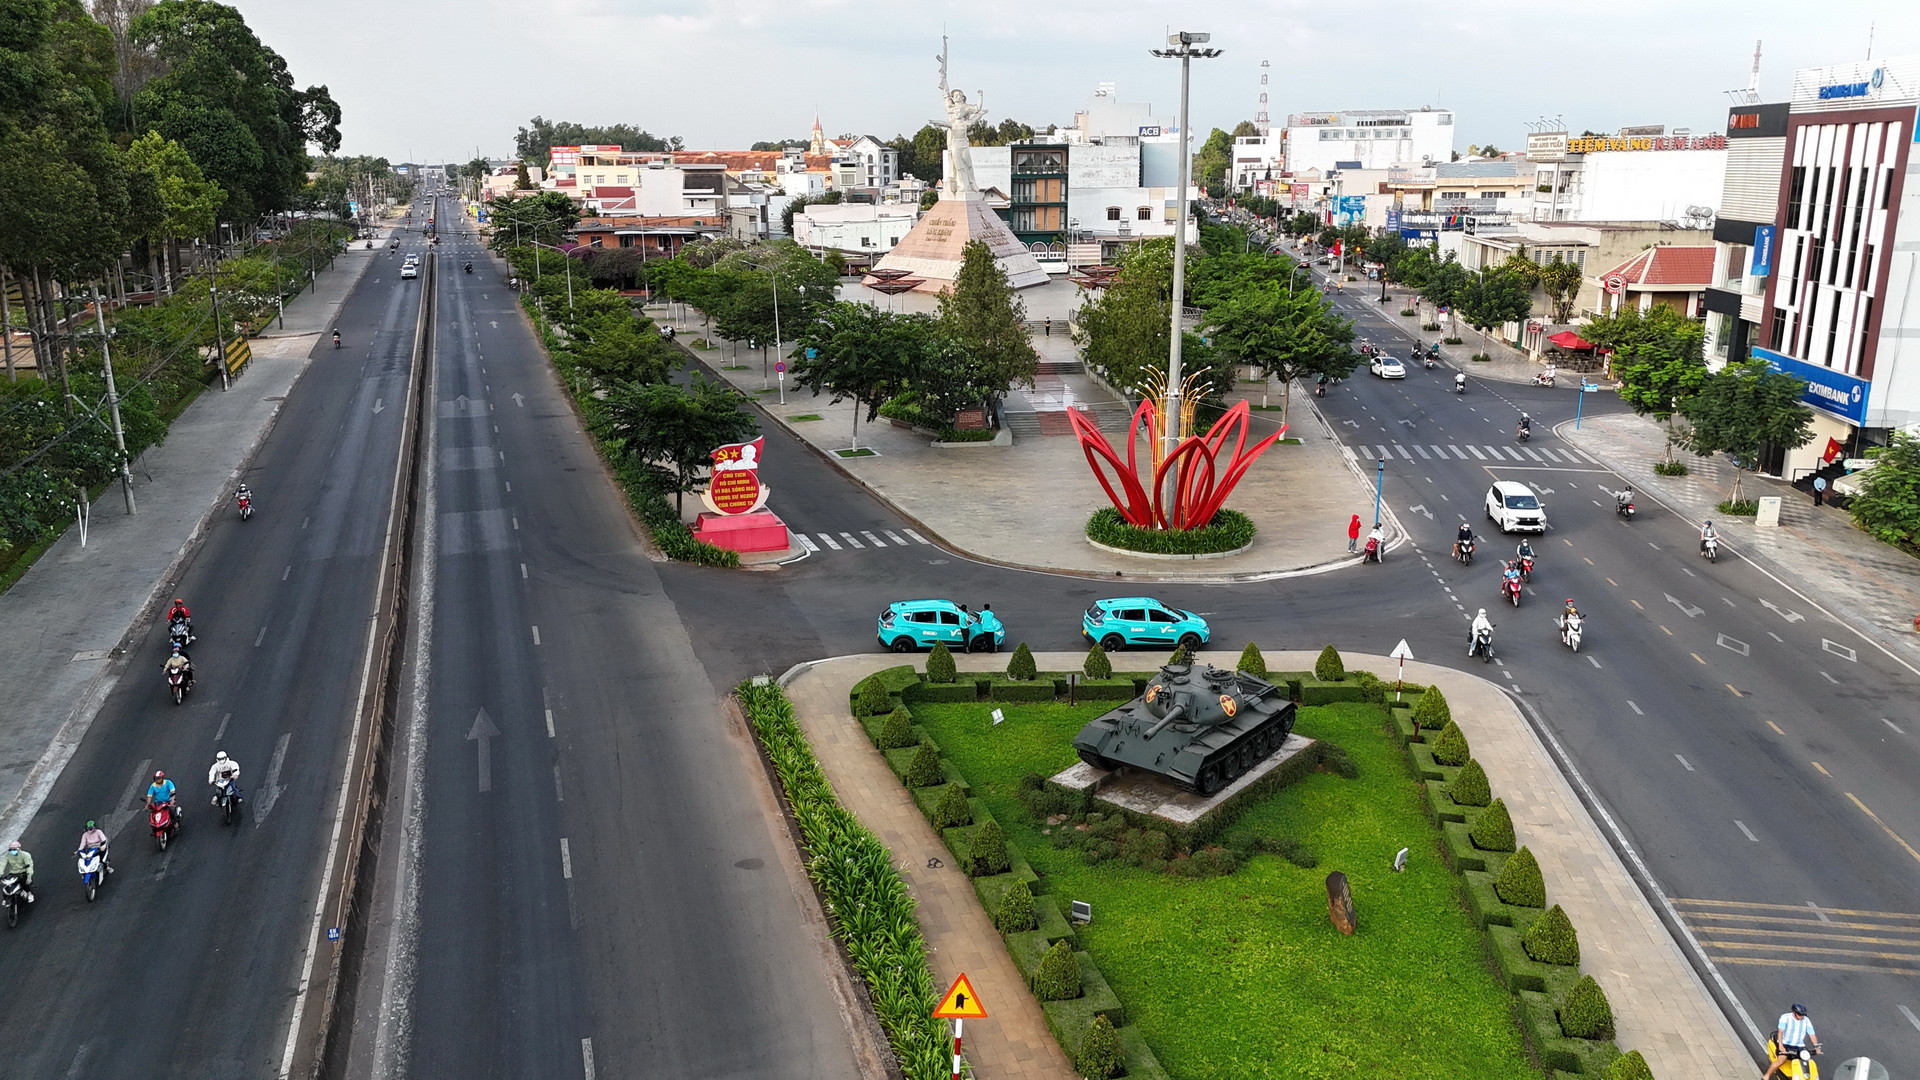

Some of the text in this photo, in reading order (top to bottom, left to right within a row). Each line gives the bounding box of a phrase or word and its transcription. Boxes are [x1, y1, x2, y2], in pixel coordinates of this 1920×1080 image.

[1141, 128, 1158, 136] ACB
[1568, 134, 1726, 154] TIỆM VÀNG KIM ANH
[1808, 381, 1850, 406] EXIMBANK
